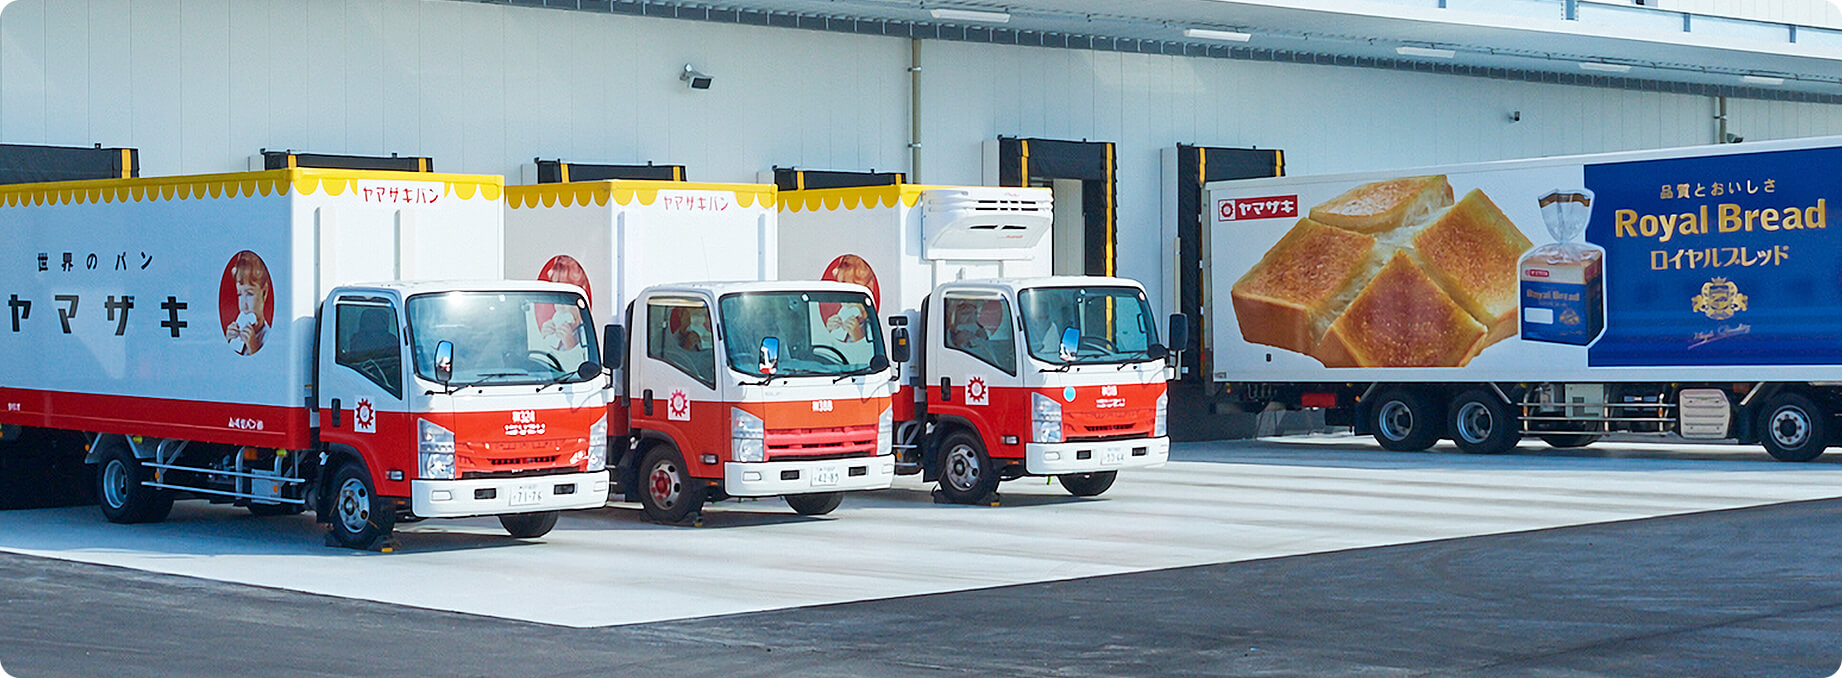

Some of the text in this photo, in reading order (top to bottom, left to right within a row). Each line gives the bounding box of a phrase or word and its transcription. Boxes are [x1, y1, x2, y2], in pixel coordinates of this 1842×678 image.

[1660, 178, 1776, 199] 品質とおいしさ
[1615, 198, 1827, 242] Royal Bread
[37, 252, 153, 272] 世界のパン
[1650, 245, 1790, 270] ロイヤルブレッド
[8, 294, 188, 338] ヤマザキ
